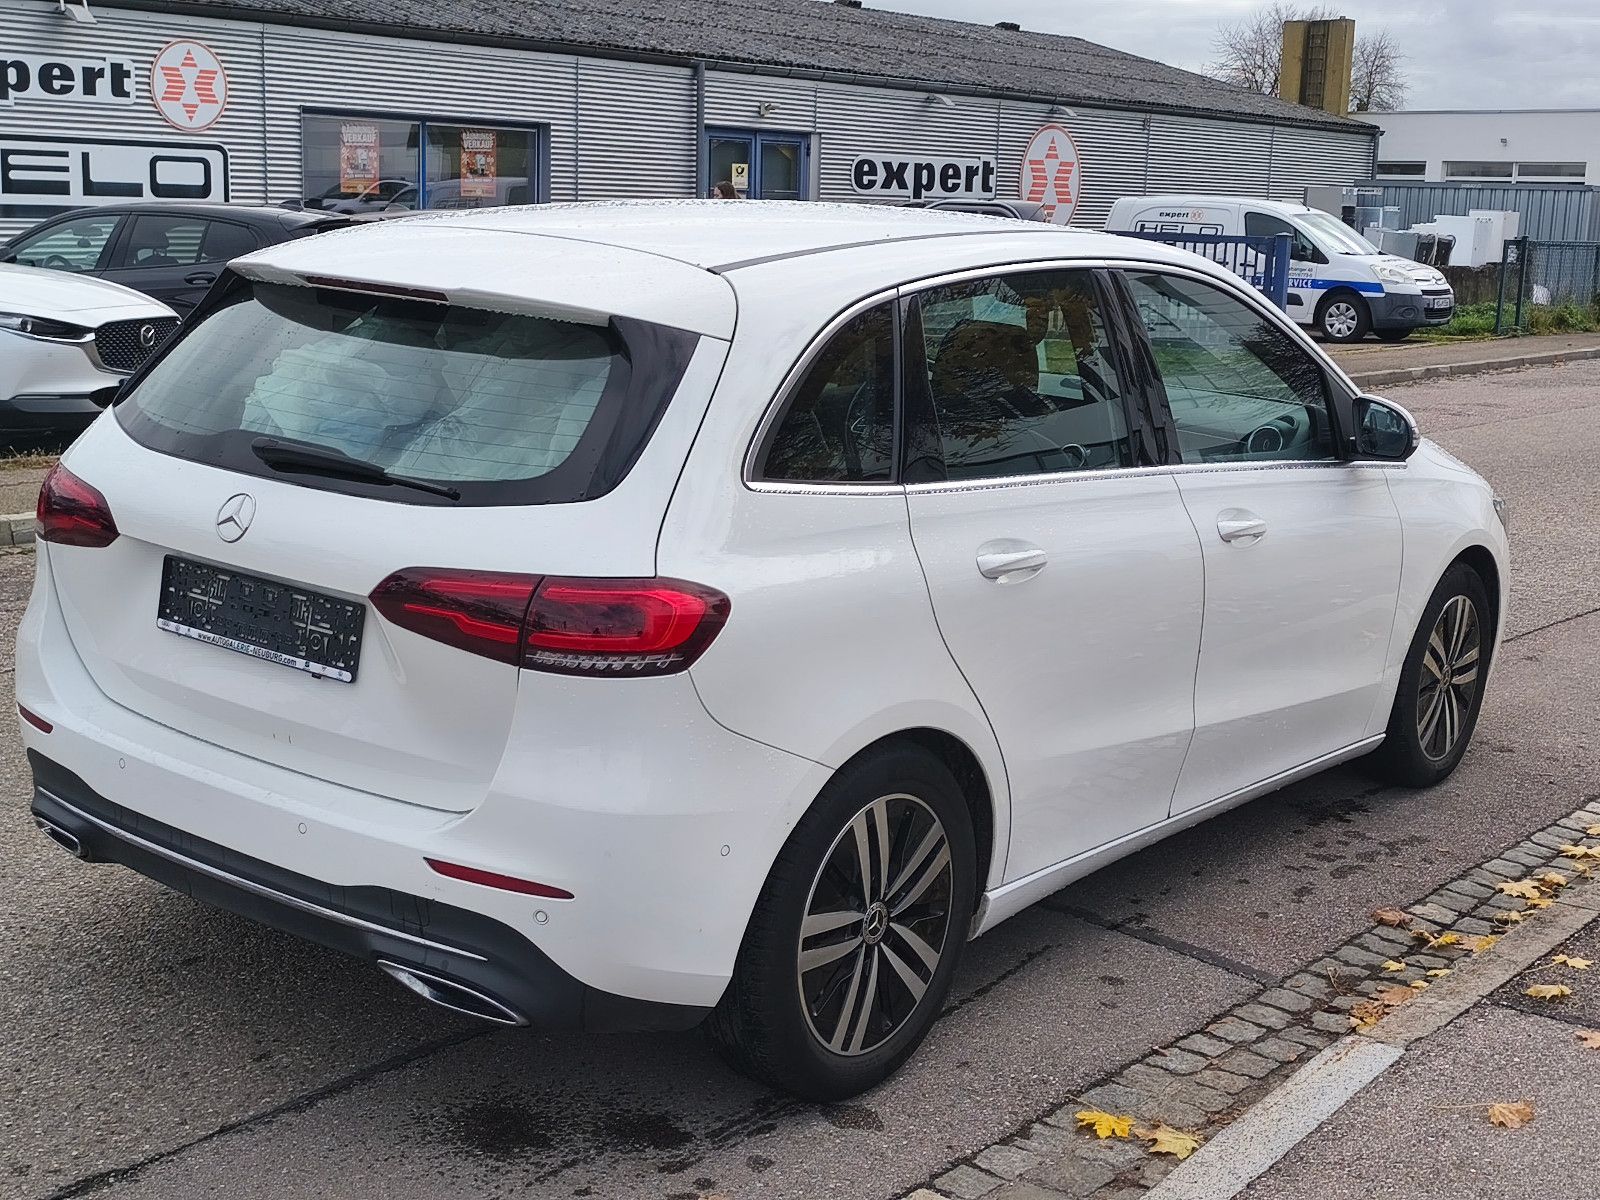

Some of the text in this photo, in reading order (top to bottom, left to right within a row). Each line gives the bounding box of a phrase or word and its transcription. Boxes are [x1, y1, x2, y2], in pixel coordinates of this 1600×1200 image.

[343, 133, 376, 143] VERKAUF
[464, 139, 494, 149] VERKAUF
[853, 158, 995, 200] expert
[1159, 211, 1189, 219] expert
[197, 632, 297, 667] www.AUTOGALERIE-NEUBURG.com
